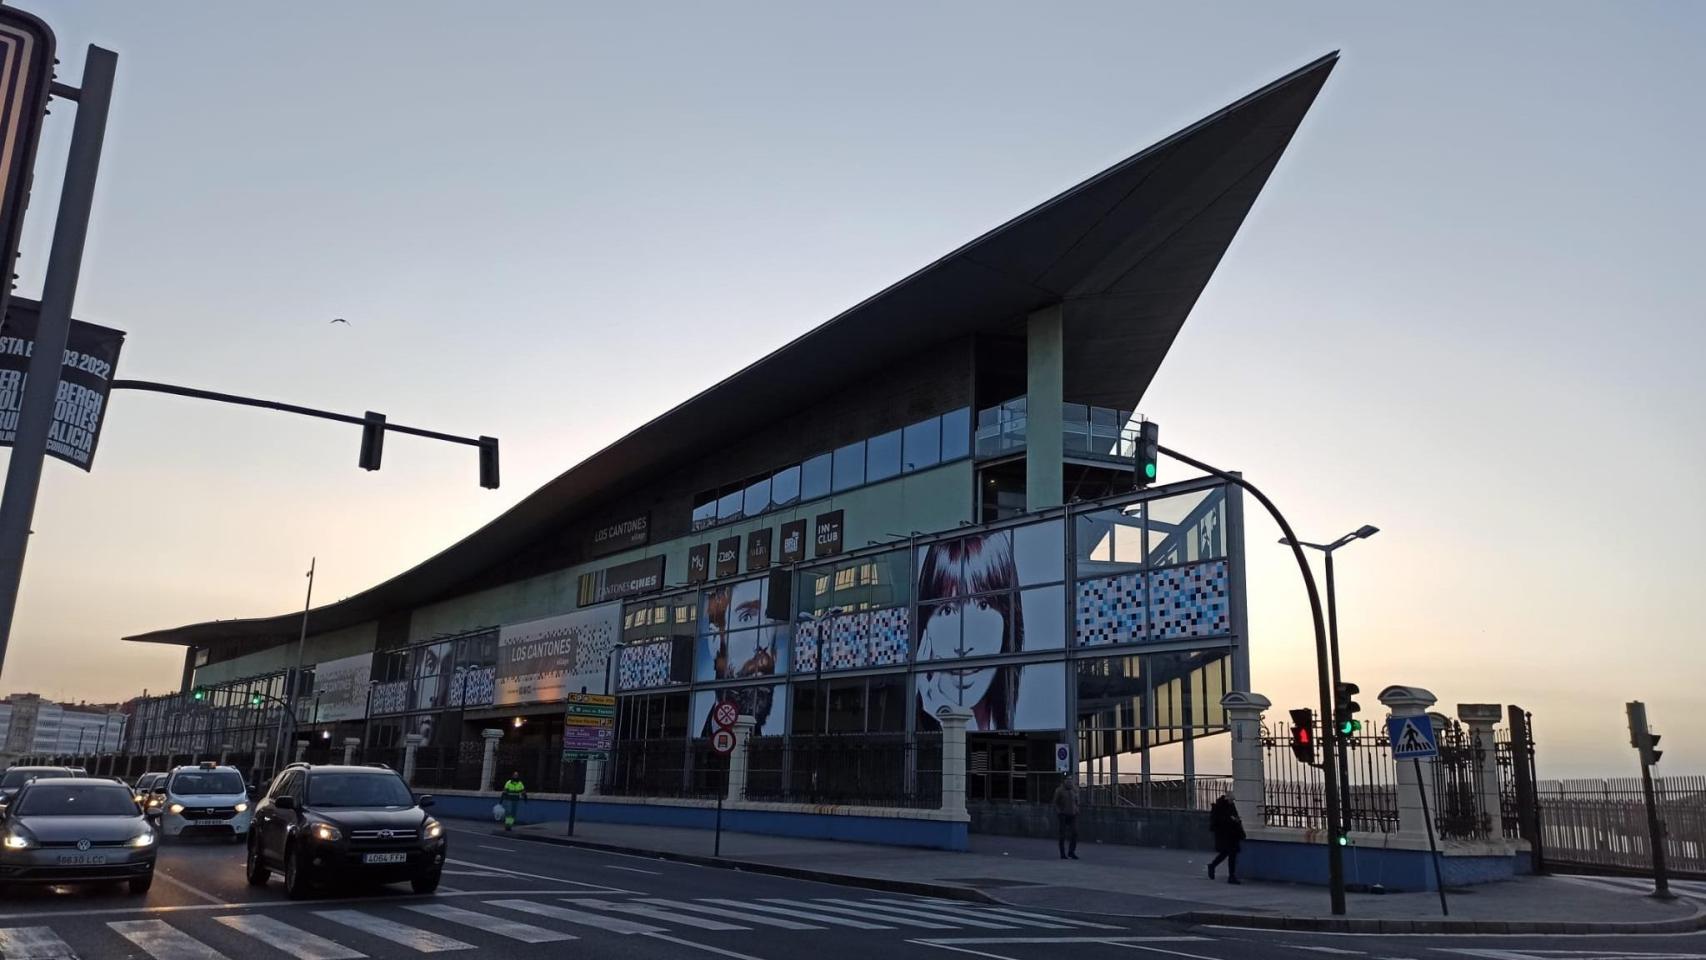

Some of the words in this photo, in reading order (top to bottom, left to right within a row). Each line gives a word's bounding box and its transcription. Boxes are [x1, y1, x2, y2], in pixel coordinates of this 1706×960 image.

[595, 527, 608, 543] LOS
[608, 516, 647, 538] CANTONES
[817, 531, 838, 545] CLUB
[691, 555, 704, 572] My
[630, 575, 657, 590] CINES
[511, 645, 527, 662] LOS
[527, 638, 571, 660] CANTONES
